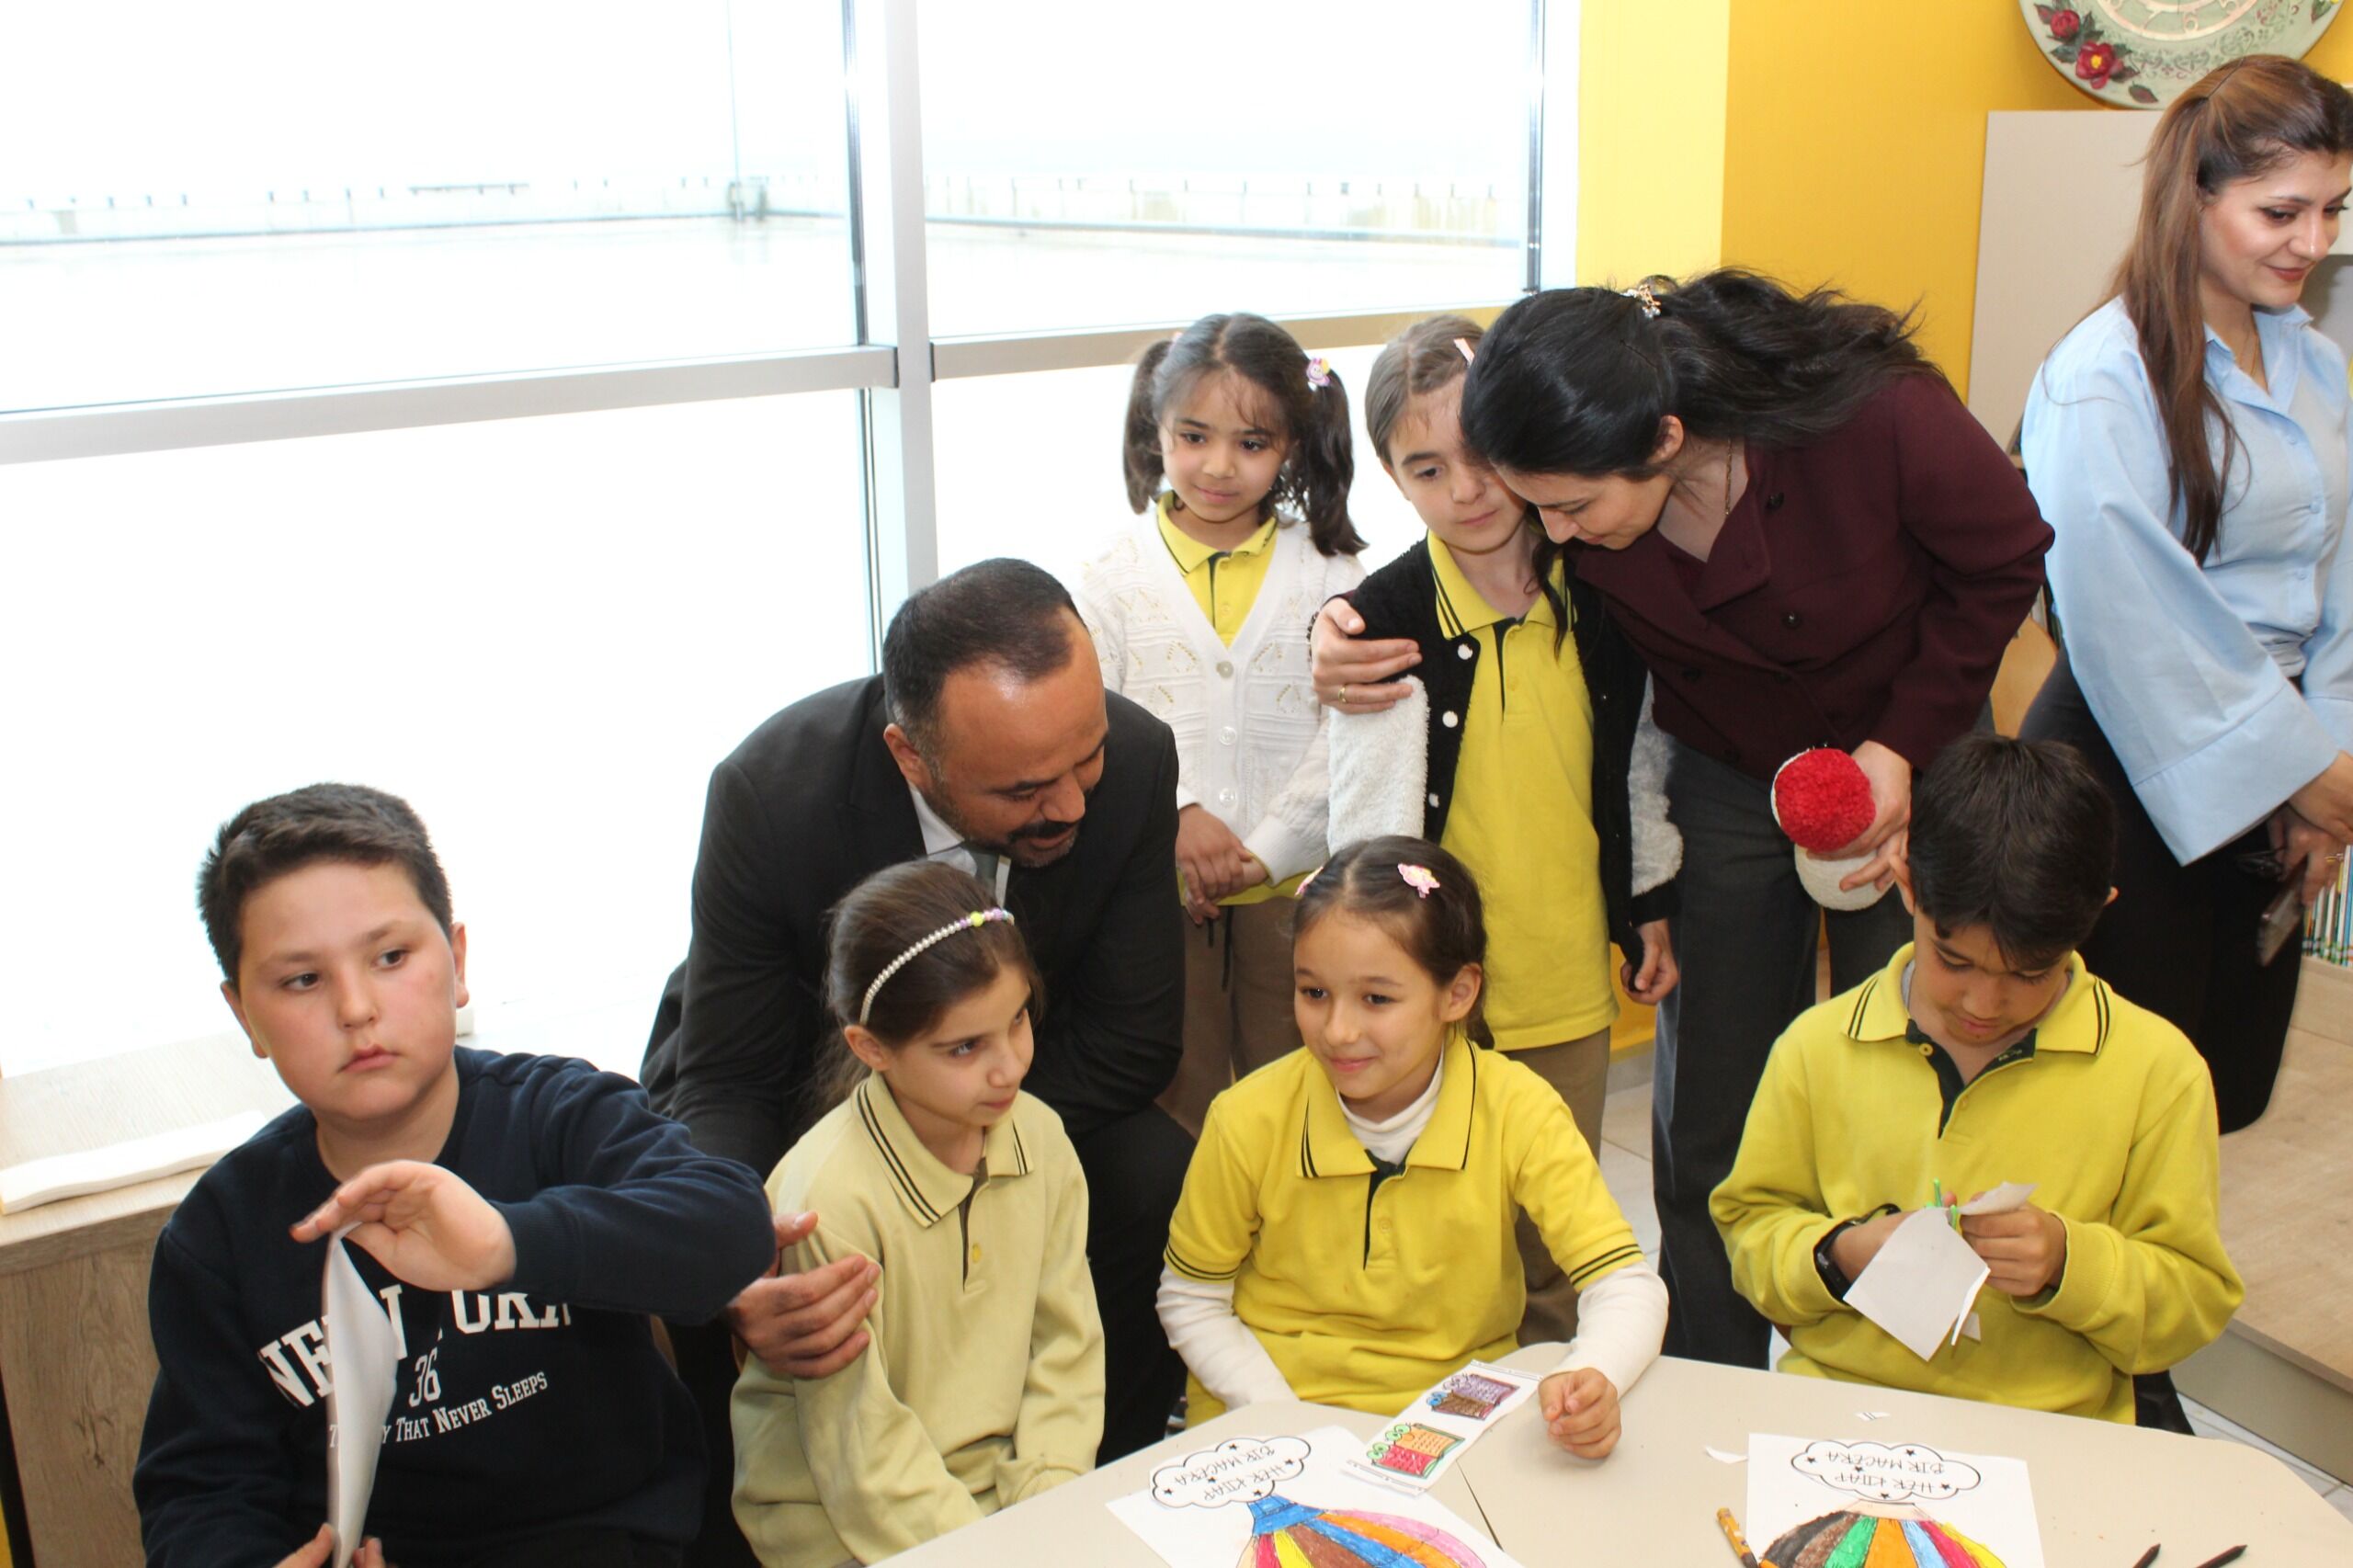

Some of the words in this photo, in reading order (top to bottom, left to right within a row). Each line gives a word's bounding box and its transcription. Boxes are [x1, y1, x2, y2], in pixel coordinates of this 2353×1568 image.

[438, 1290, 572, 1341] OR
[396, 1417, 430, 1442] THAT
[432, 1397, 492, 1435] NEVER
[492, 1371, 548, 1410] SLEEPS
[409, 1347, 441, 1407] 36
